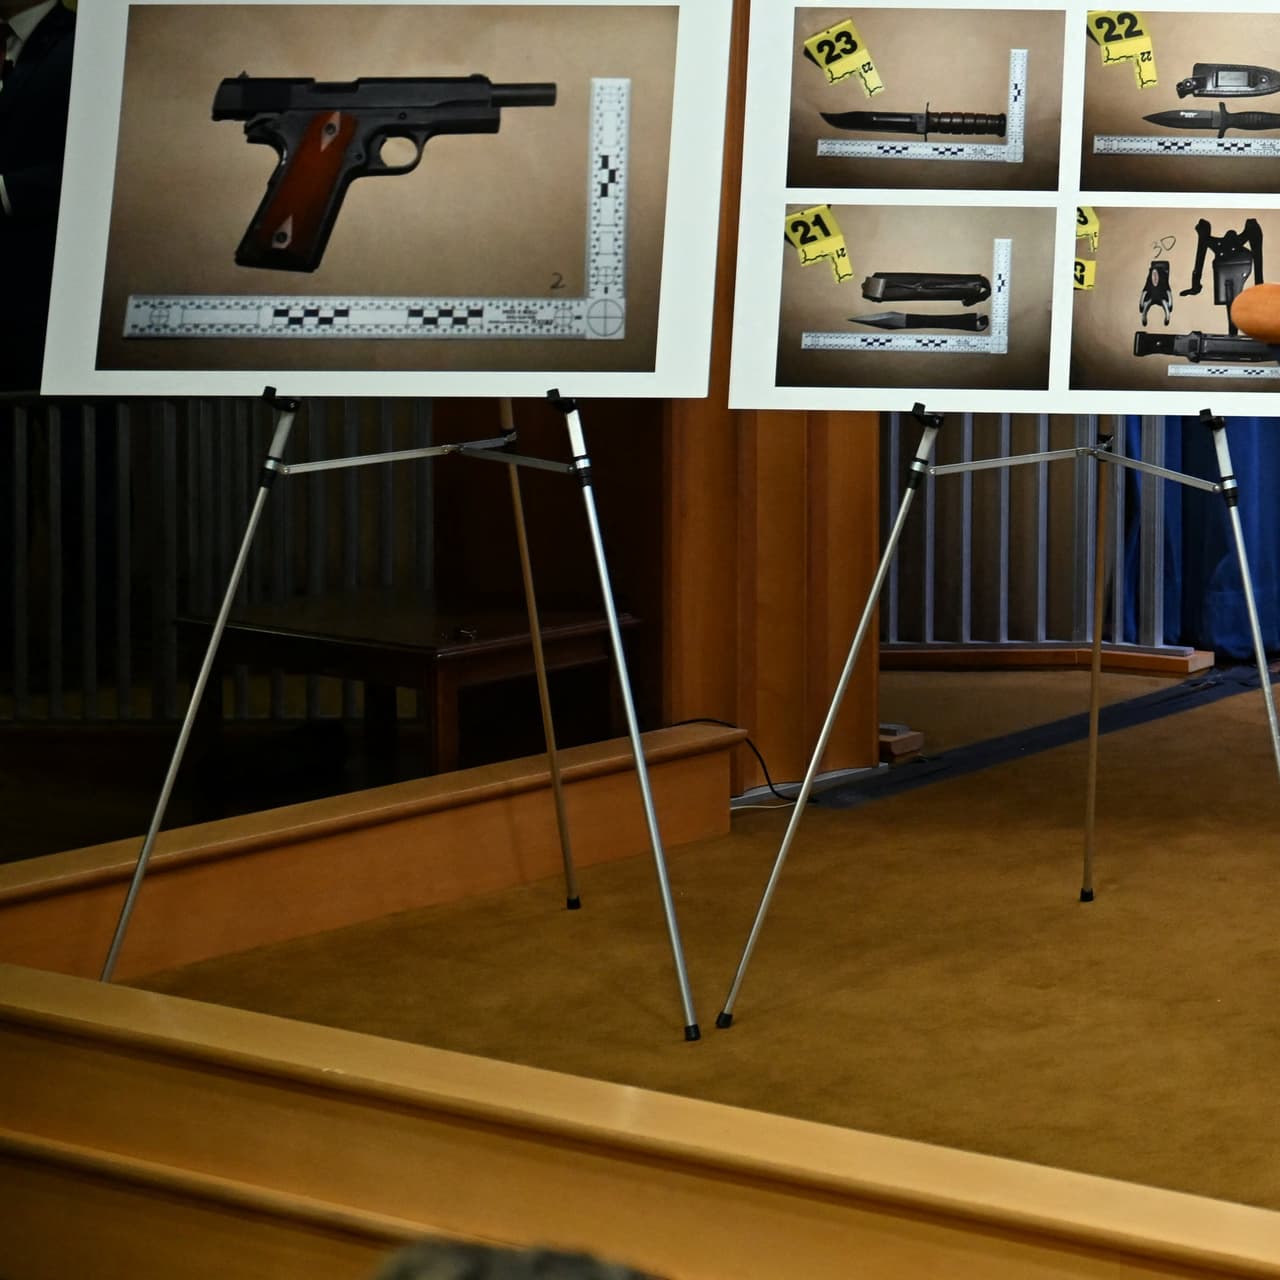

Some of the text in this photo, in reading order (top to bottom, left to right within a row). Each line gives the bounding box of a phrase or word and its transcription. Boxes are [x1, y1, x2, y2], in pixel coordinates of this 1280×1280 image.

[1095, 12, 1144, 43] 22
[816, 31, 858, 65] 23
[791, 214, 831, 245] 21
[550, 272, 566, 289] 2
